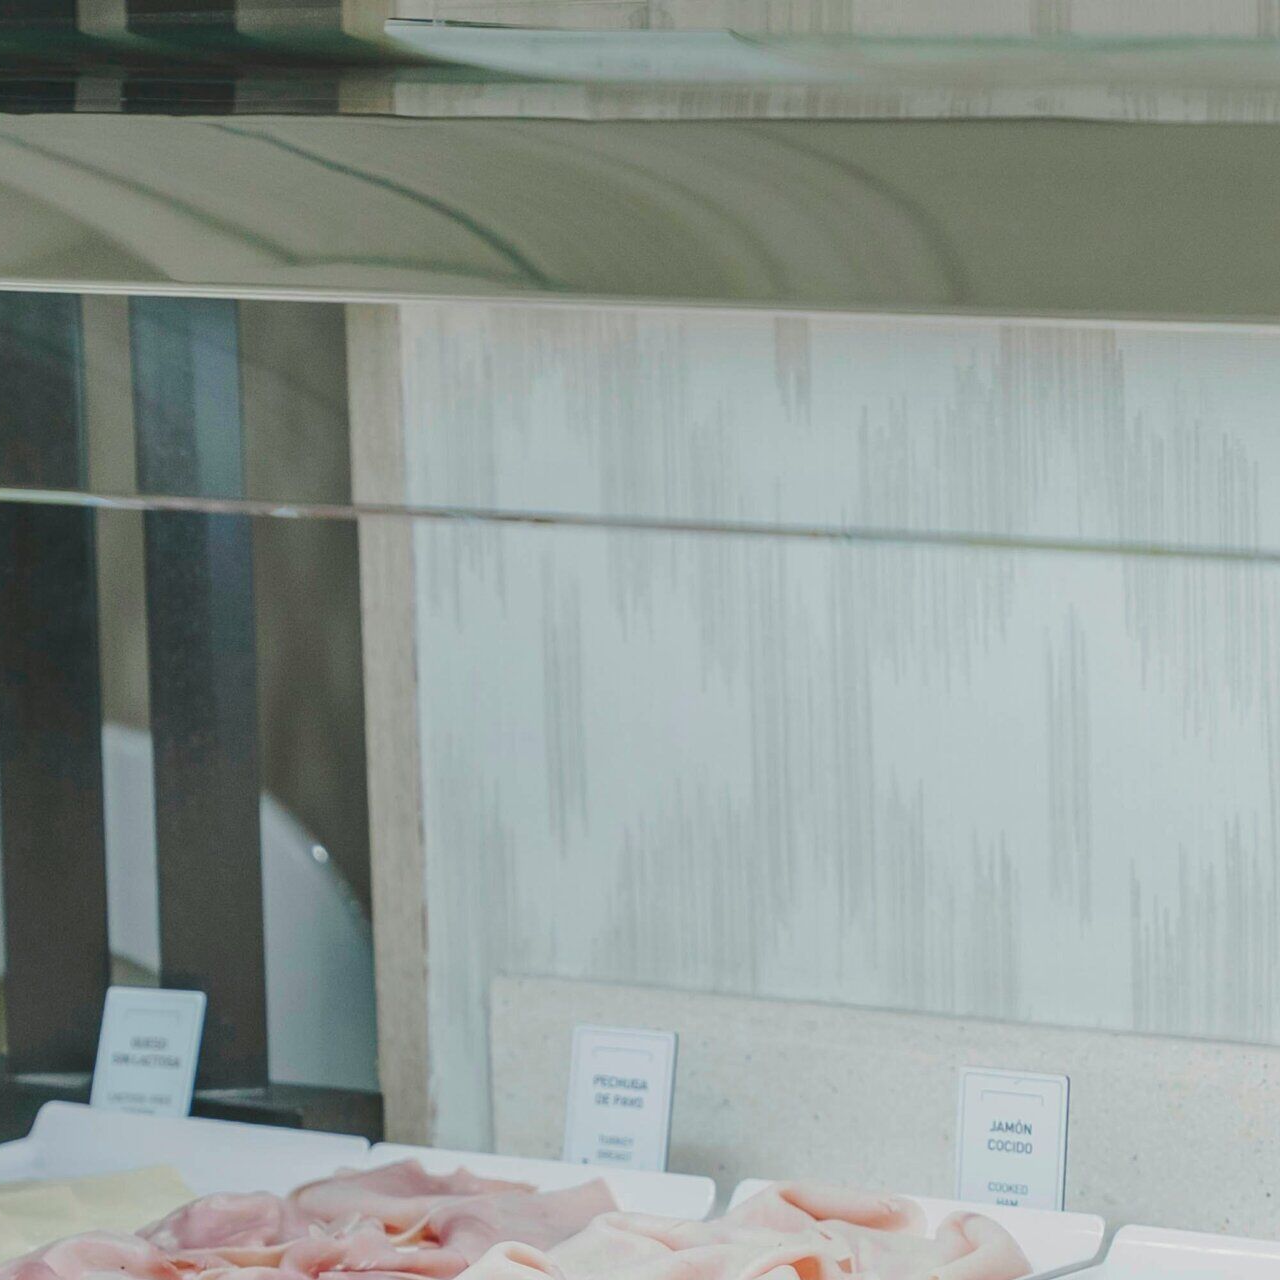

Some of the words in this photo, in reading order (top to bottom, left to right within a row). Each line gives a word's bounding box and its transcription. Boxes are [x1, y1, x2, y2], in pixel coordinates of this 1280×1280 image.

[592, 1074, 648, 1090] PECHUGA
[595, 1093, 609, 1105] DE
[613, 1095, 643, 1108] PAVO
[990, 1119, 1032, 1135] JAMÓN
[988, 1139, 1033, 1154] COCIDO
[988, 1182, 1028, 1195] COOKED
